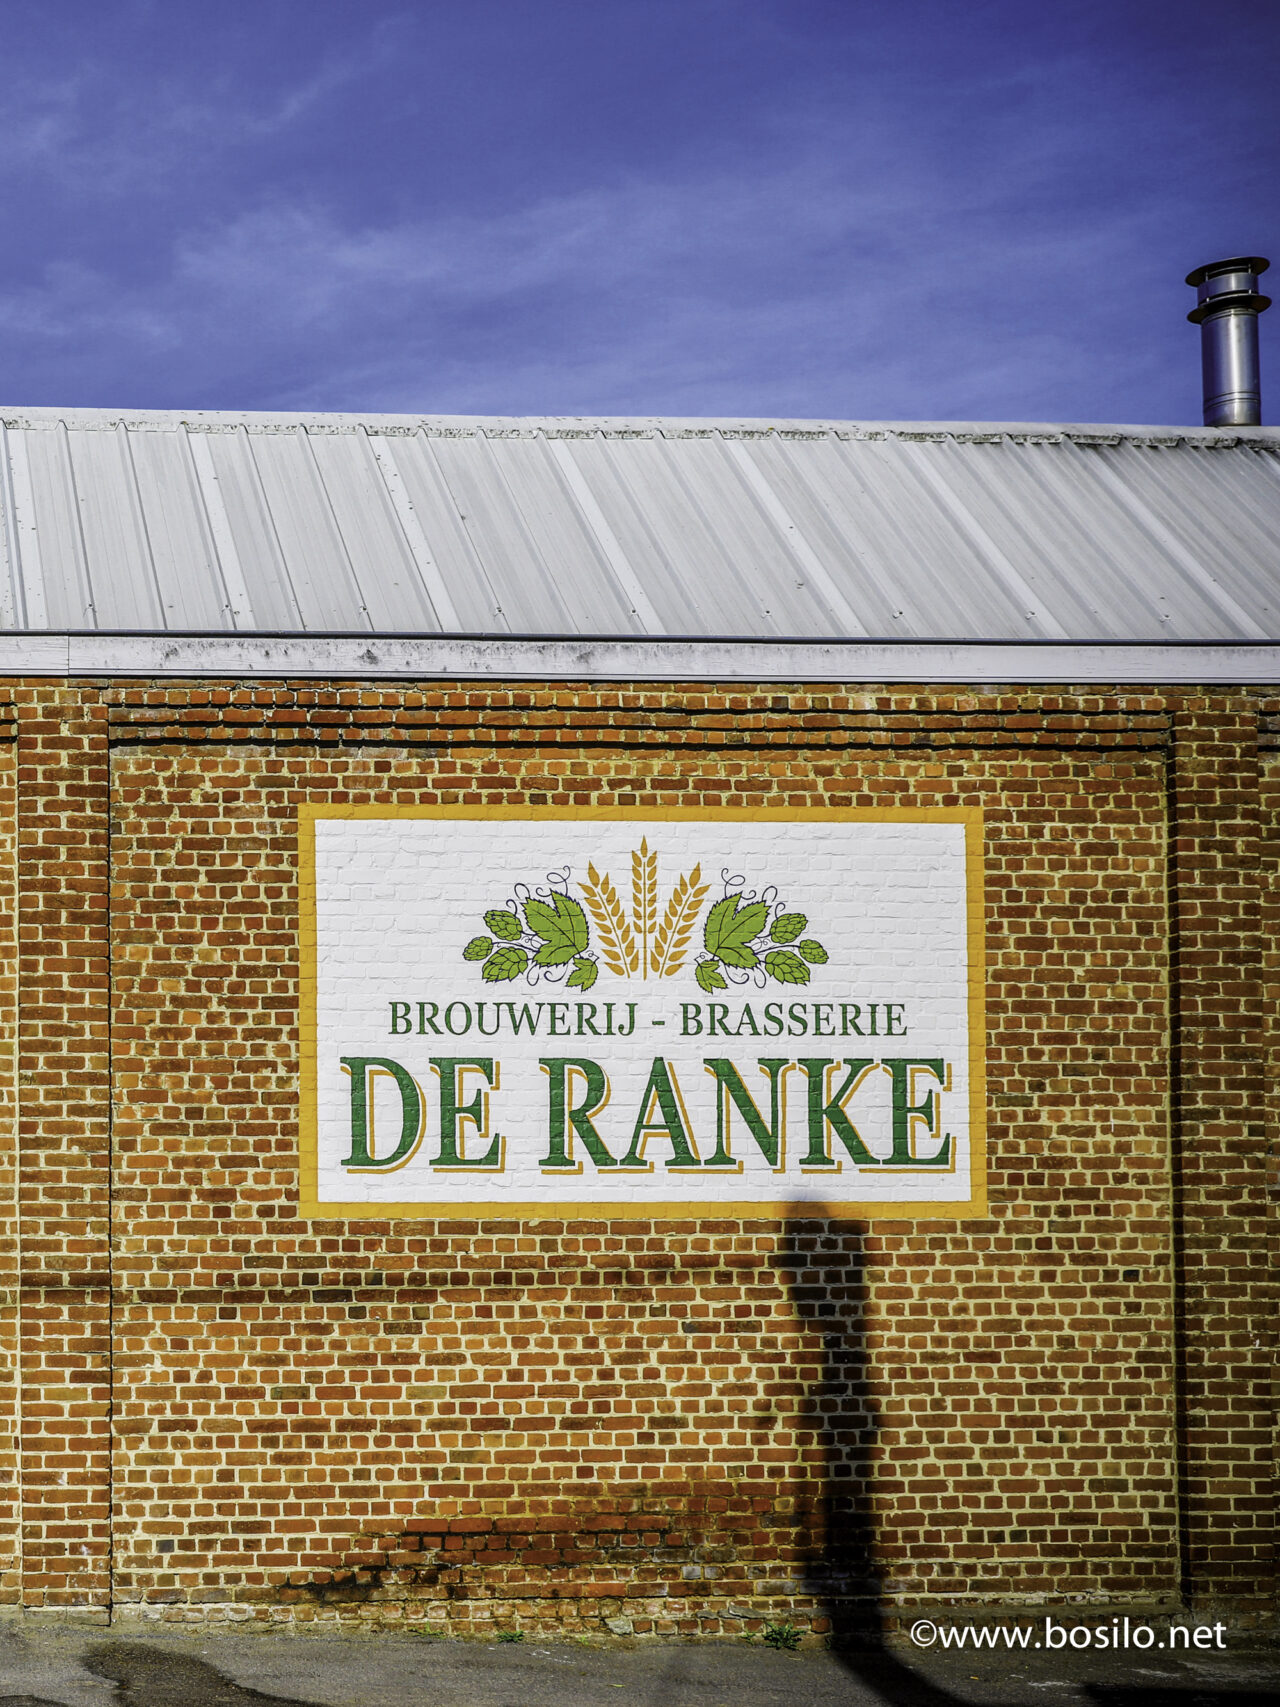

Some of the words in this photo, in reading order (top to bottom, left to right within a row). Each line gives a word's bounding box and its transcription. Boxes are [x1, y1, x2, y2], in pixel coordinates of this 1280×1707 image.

[389, 1002, 638, 1036] BROUWERIJ
[680, 1003, 907, 1036] BRASSERIE
[340, 1057, 506, 1174] DE
[539, 1057, 956, 1175] RANKE
